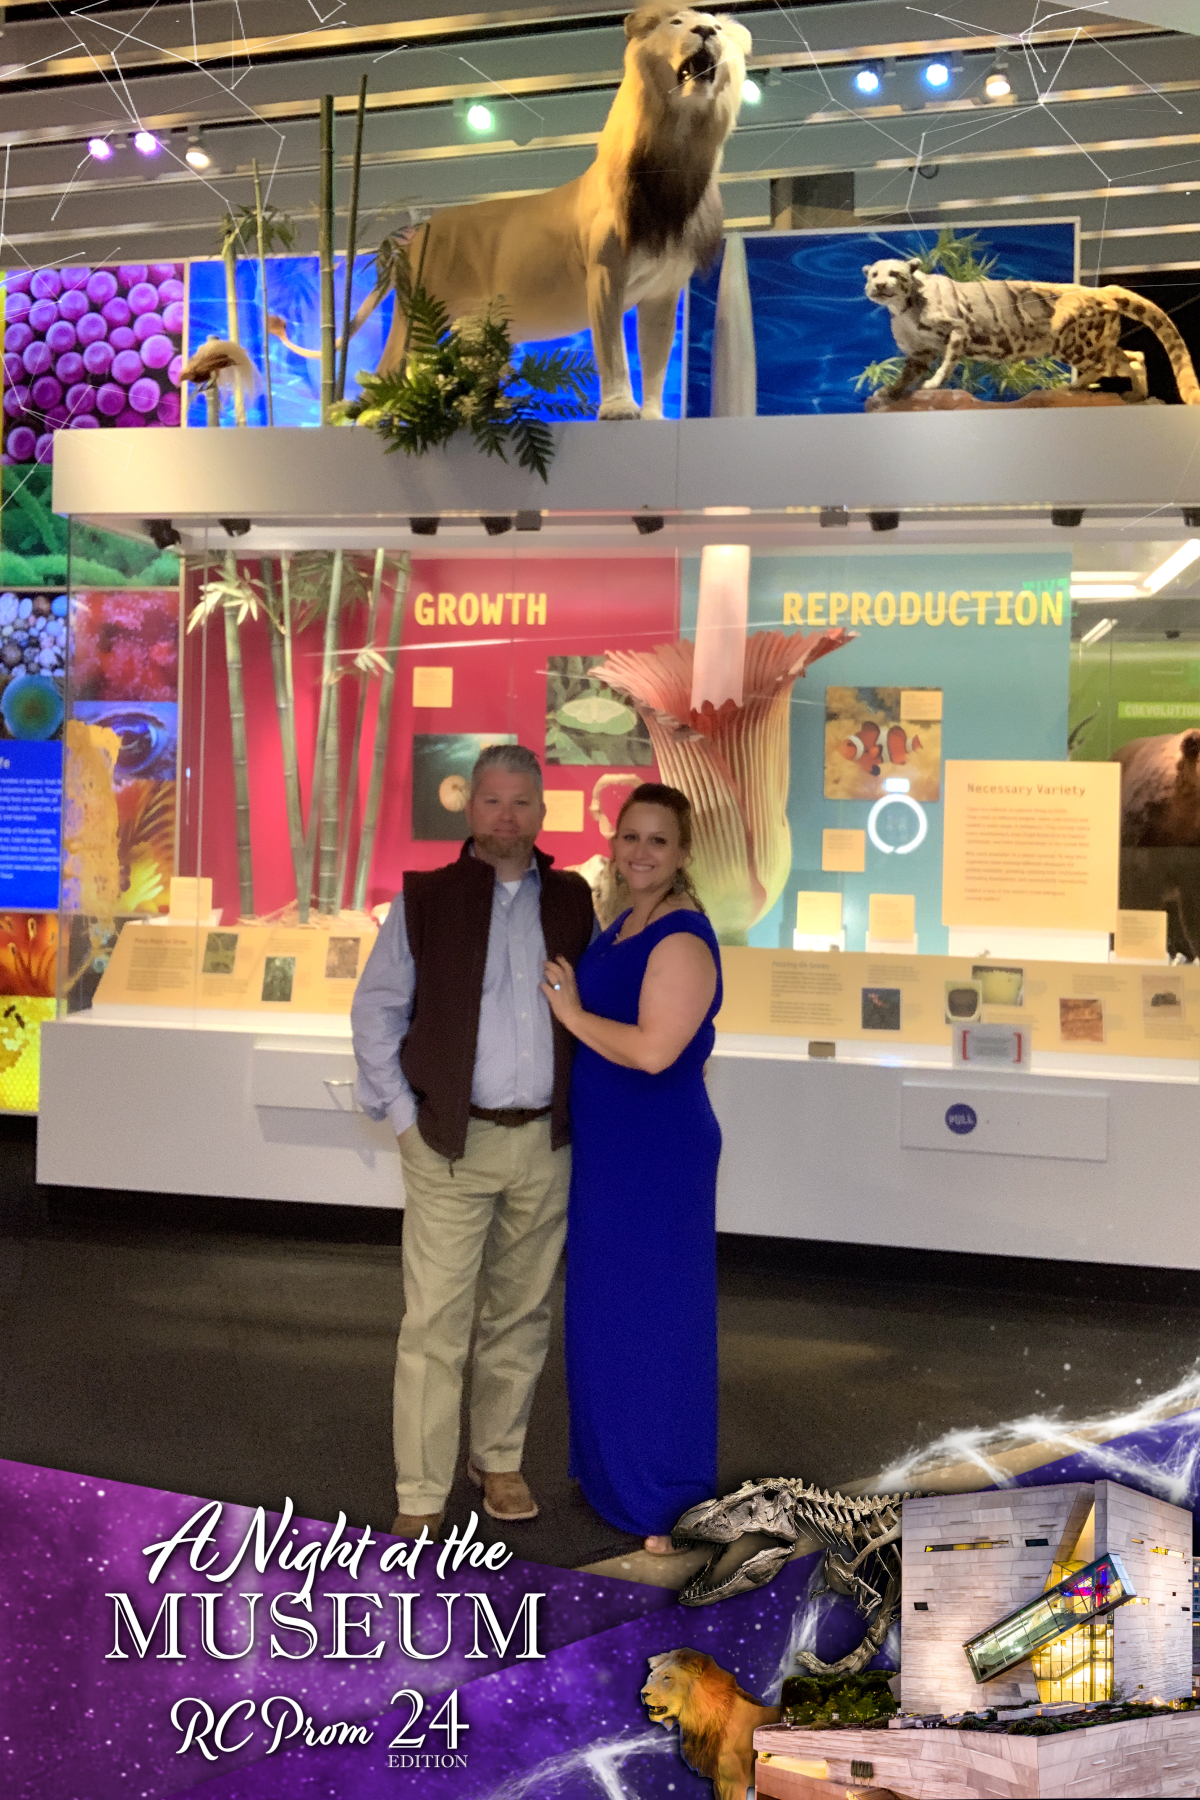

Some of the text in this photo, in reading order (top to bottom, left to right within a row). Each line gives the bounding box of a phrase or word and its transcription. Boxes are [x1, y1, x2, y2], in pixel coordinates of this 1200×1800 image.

[414, 592, 547, 626] GROWTH
[782, 590, 1064, 627] REPRODUCTION
[967, 783, 1087, 797] Necessary Variety
